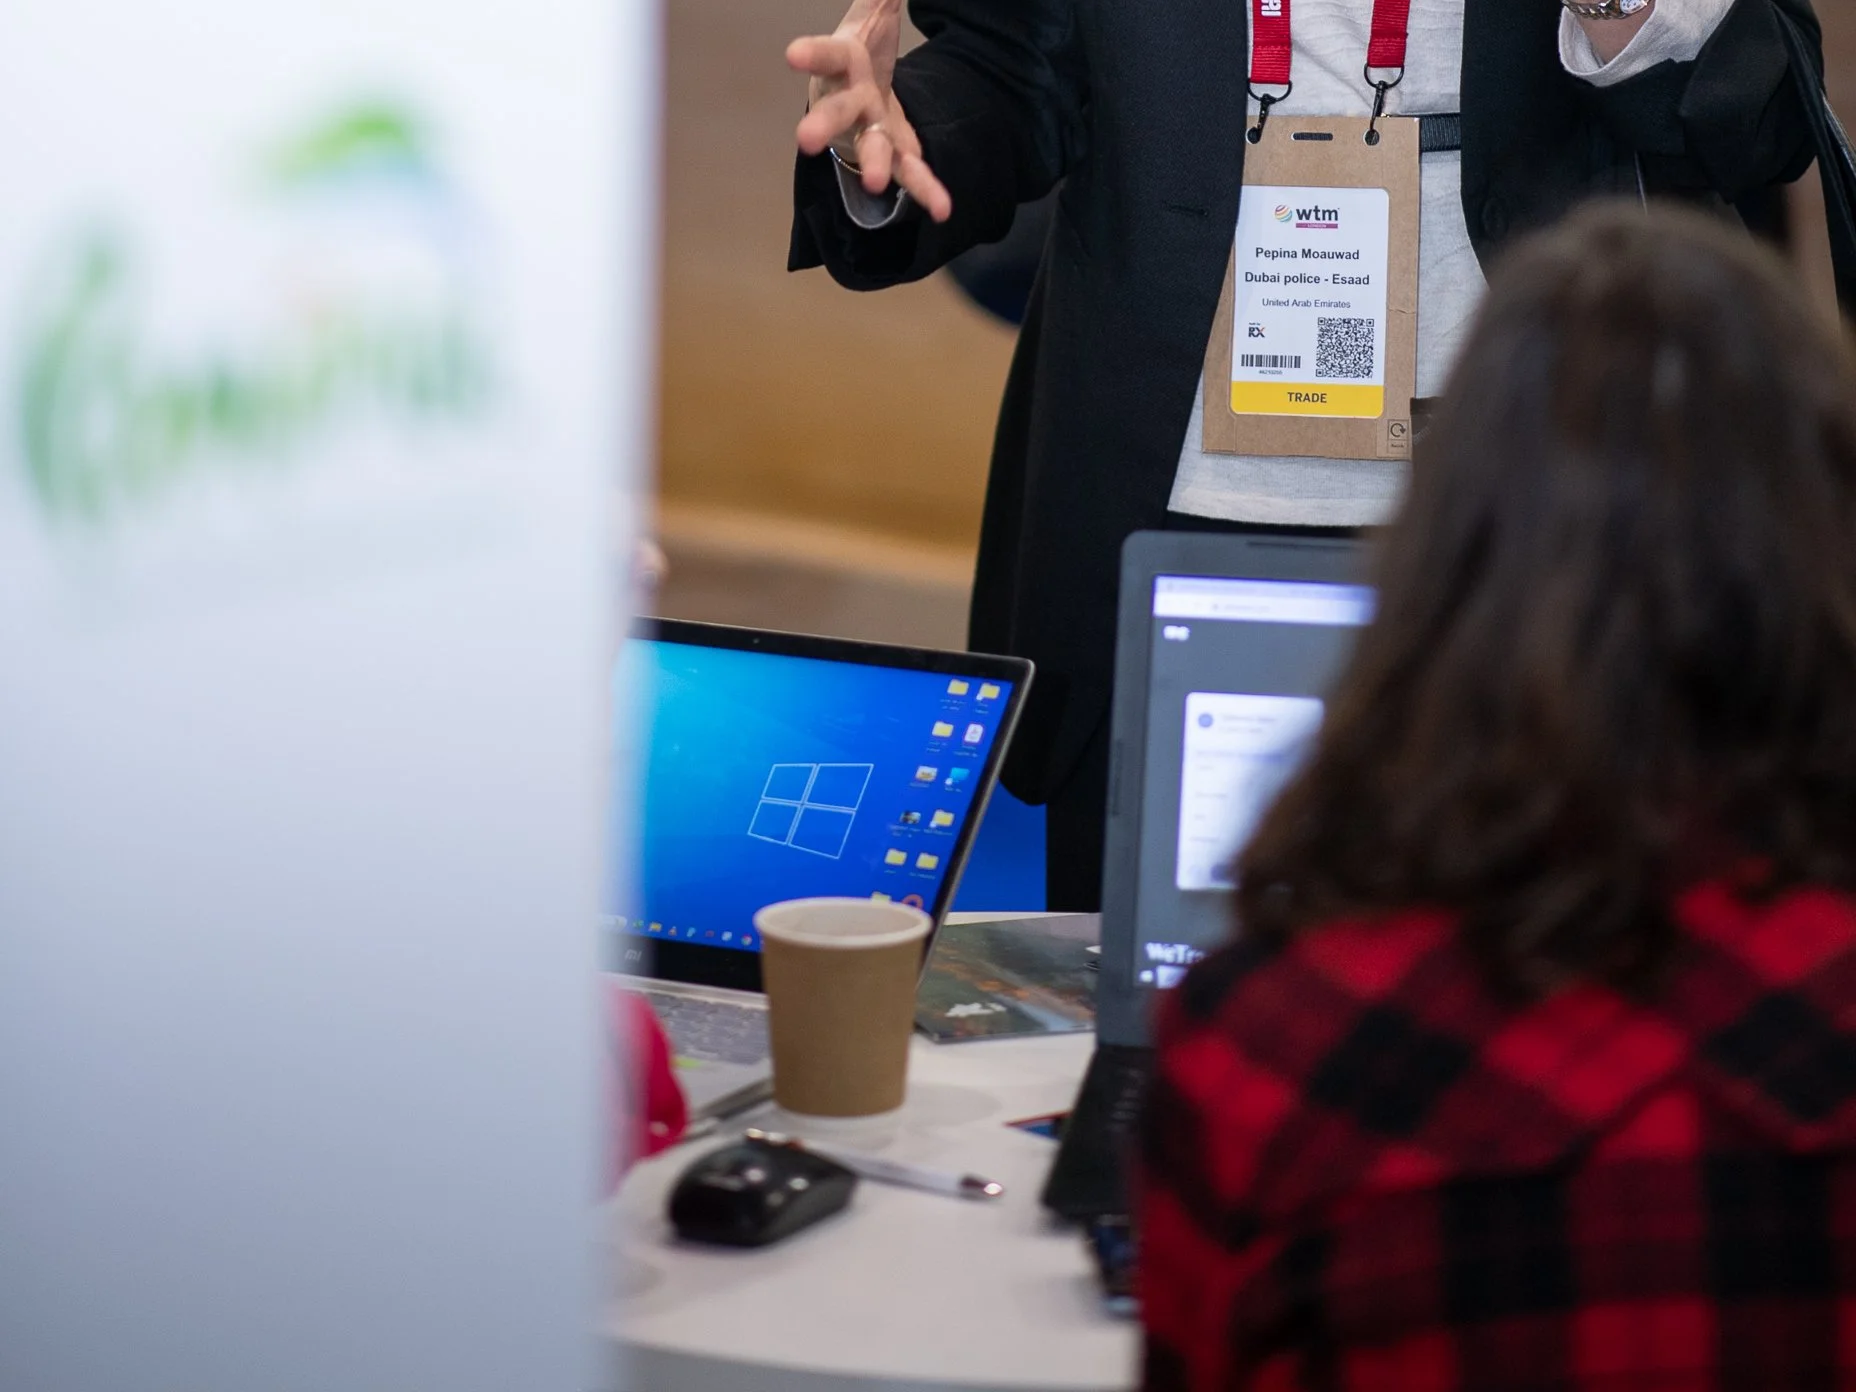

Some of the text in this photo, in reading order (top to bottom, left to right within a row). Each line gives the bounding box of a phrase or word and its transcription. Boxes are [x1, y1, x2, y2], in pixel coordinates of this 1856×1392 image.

[1295, 205, 1339, 221] wtm
[1255, 247, 1360, 261] Pepina Moauwad
[1244, 271, 1281, 283] Dubai
[1283, 272, 1321, 286] police
[1332, 273, 1370, 285] Esaad
[1261, 297, 1351, 309] United Arab Emirates
[1287, 391, 1328, 404] TRADE
